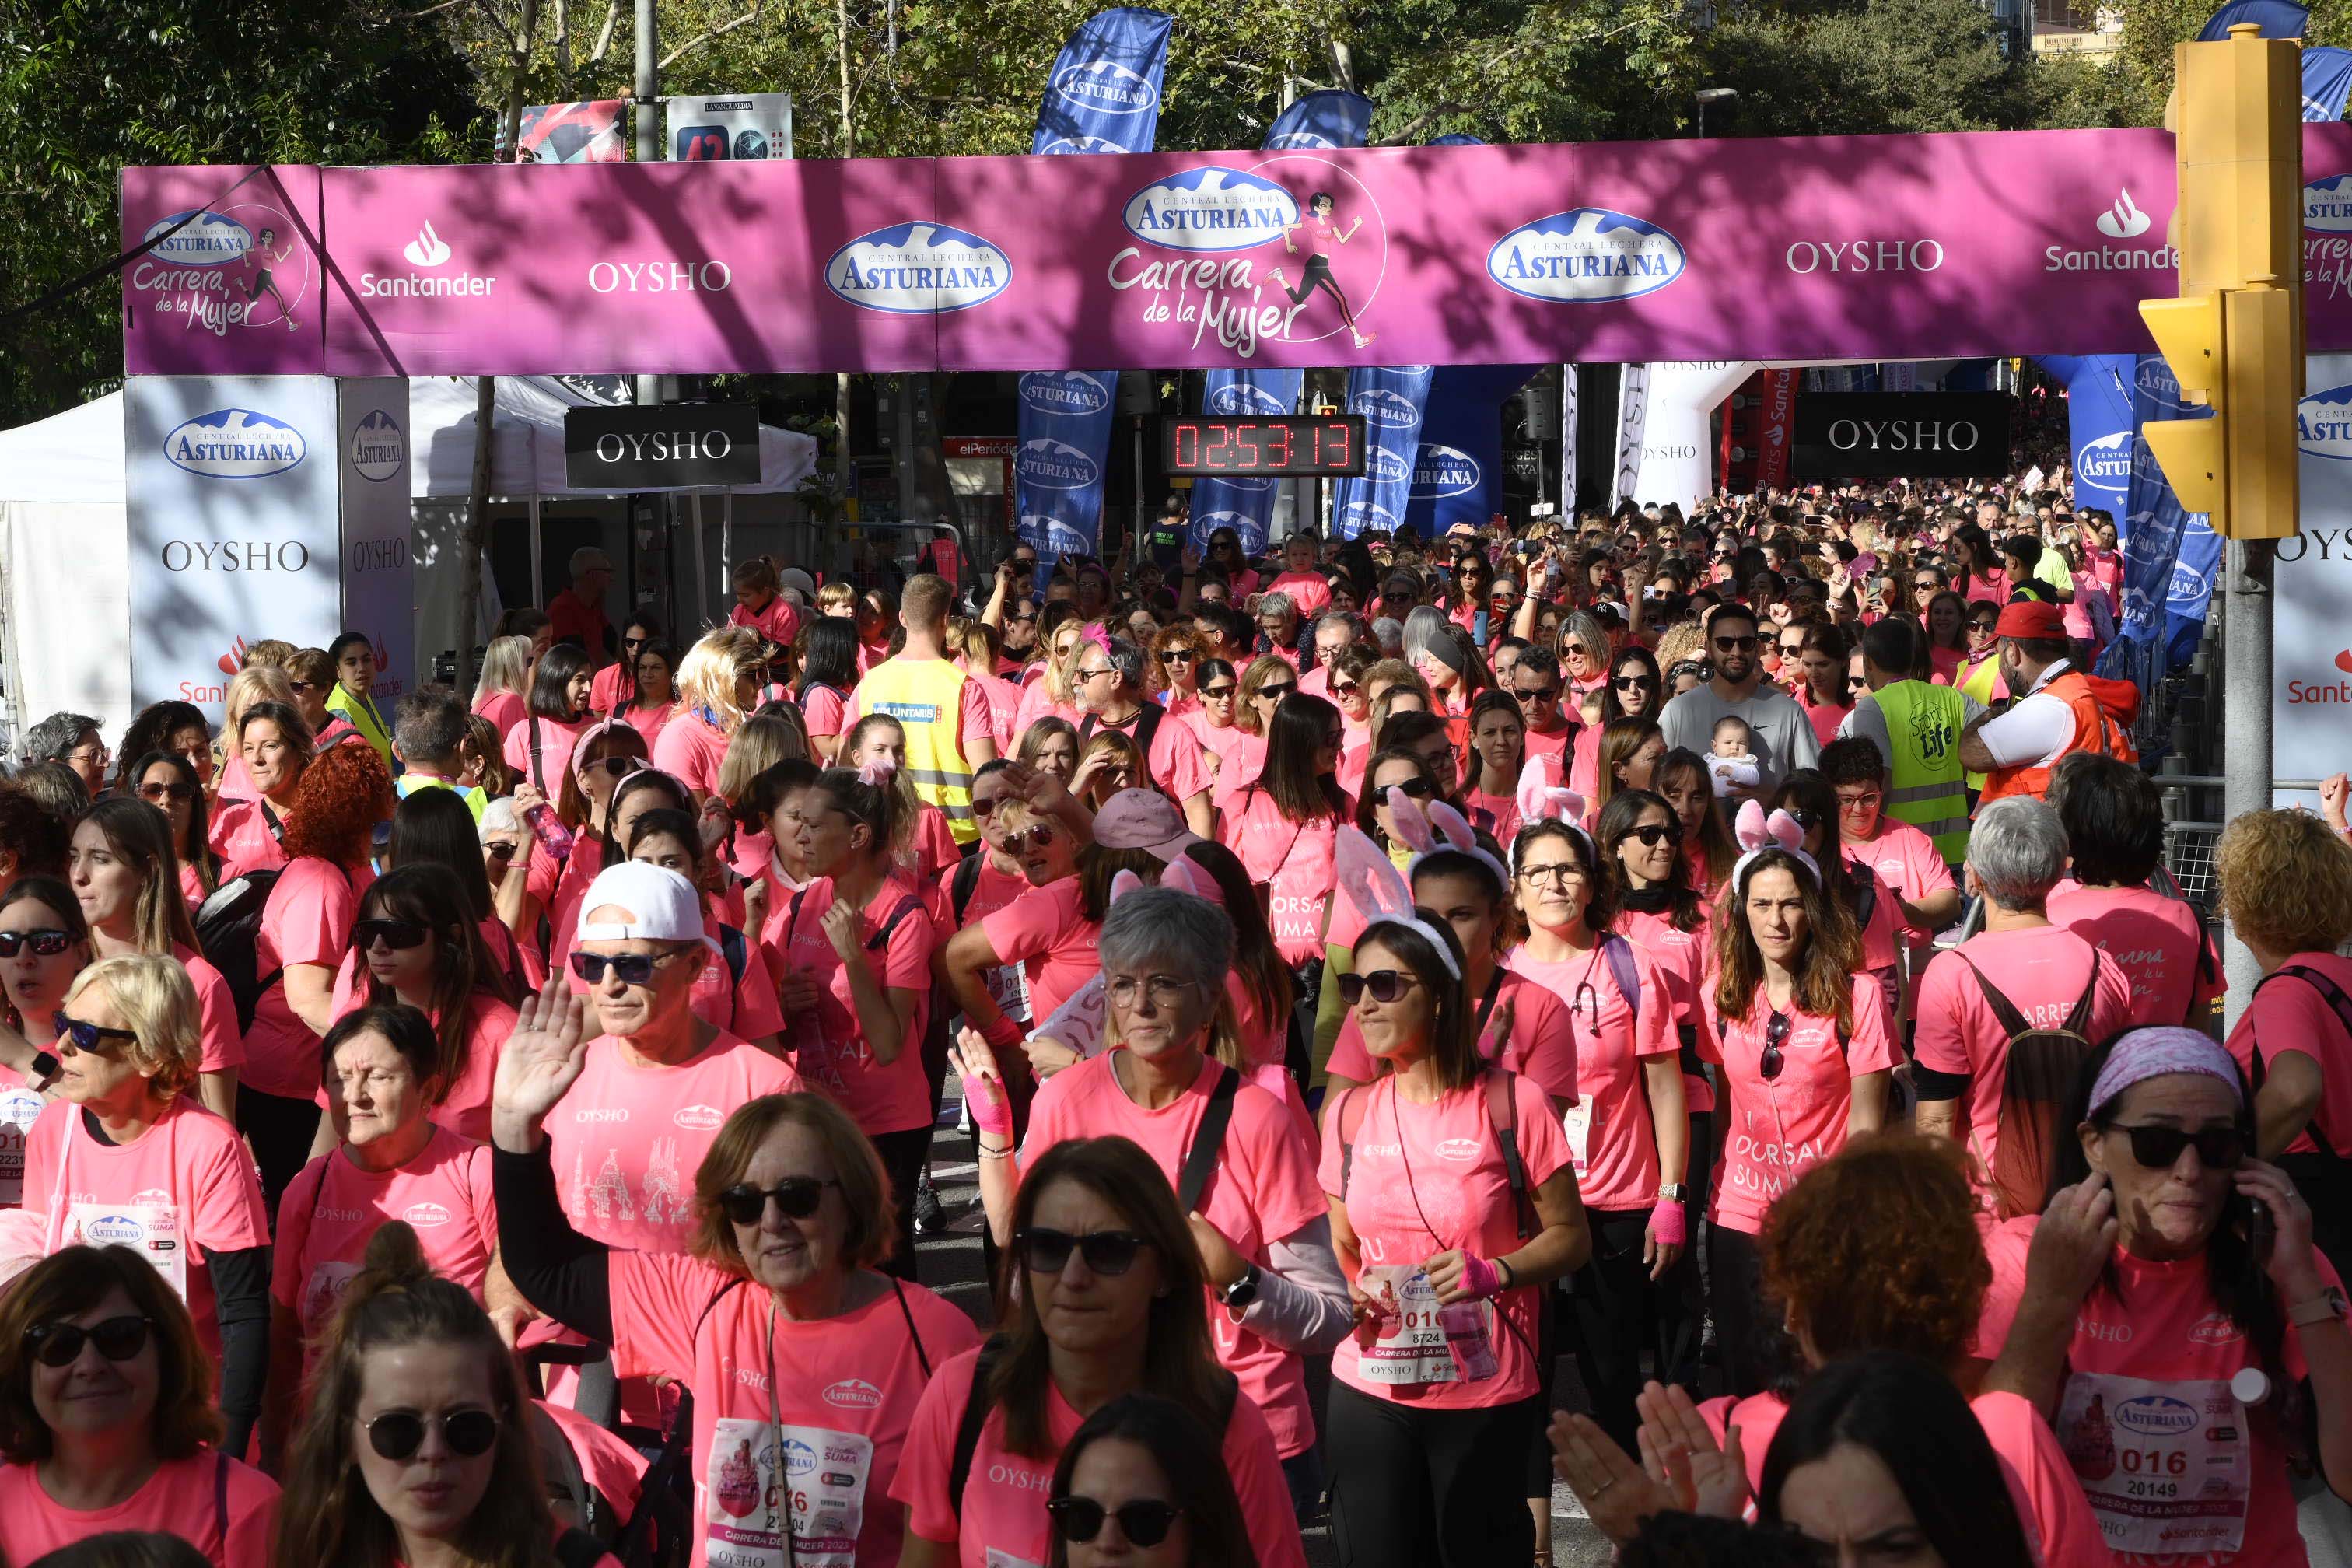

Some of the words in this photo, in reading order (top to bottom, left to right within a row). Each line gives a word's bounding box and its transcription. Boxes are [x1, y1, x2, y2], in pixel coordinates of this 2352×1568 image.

[1062, 73, 1148, 106] ASTURIANA
[1223, 196, 1280, 205] LECHERA
[1136, 199, 1284, 230] ASTURIANA
[156, 230, 243, 252] ASTURIANA
[1533, 241, 1594, 251] CENTRAL
[1601, 240, 1664, 250] LECHERA
[868, 254, 926, 263] CENTRAL
[933, 253, 991, 262] LECHERA
[1108, 247, 1253, 290] Carrera
[1503, 245, 1670, 279] ASTURIANA
[1786, 239, 1944, 273] OYSHO
[133, 262, 223, 291] Carrera
[588, 261, 731, 292] OYSHO
[839, 257, 997, 290] ASTURIANA
[2319, 259, 2332, 282] la
[361, 273, 495, 298] Santander
[156, 292, 173, 312] de
[177, 291, 188, 312] la
[187, 289, 258, 337] Mujer
[1143, 292, 1170, 323] de
[1176, 291, 1195, 322] la
[1192, 285, 1307, 358] Mujer
[1353, 398, 1413, 423] ASTURIANA
[596, 430, 731, 462] OYSHO
[1176, 425, 1349, 467] 02:53:13
[1829, 419, 1979, 451] OYSHO
[176, 436, 296, 461] ASTURIANA
[356, 437, 401, 464] ASTURIANA
[162, 541, 309, 572] OYSHO
[354, 537, 404, 572] OYSHO
[1911, 707, 1943, 737] Sport
[1921, 723, 1954, 760] Life
[576, 1108, 629, 1123] OYSHO
[314, 1207, 364, 1222] OYSHO
[92, 1227, 139, 1238] ASTURIANA
[1412, 1332, 1440, 1344] 8724
[1374, 1349, 1411, 1357] CARRERA
[1371, 1366, 1411, 1375] OYSHO
[828, 1388, 878, 1404] ASTURIANA
[2119, 1406, 2193, 1427] ASTURIANA
[824, 1452, 857, 1464] SUMA
[2122, 1448, 2186, 1475] 016
[2128, 1479, 2178, 1497] 20149
[725, 1530, 767, 1545] CARRERA
[796, 1539, 824, 1549] MUJER
[2172, 1524, 2230, 1539] Santander
[719, 1549, 765, 1568] OYSHO
